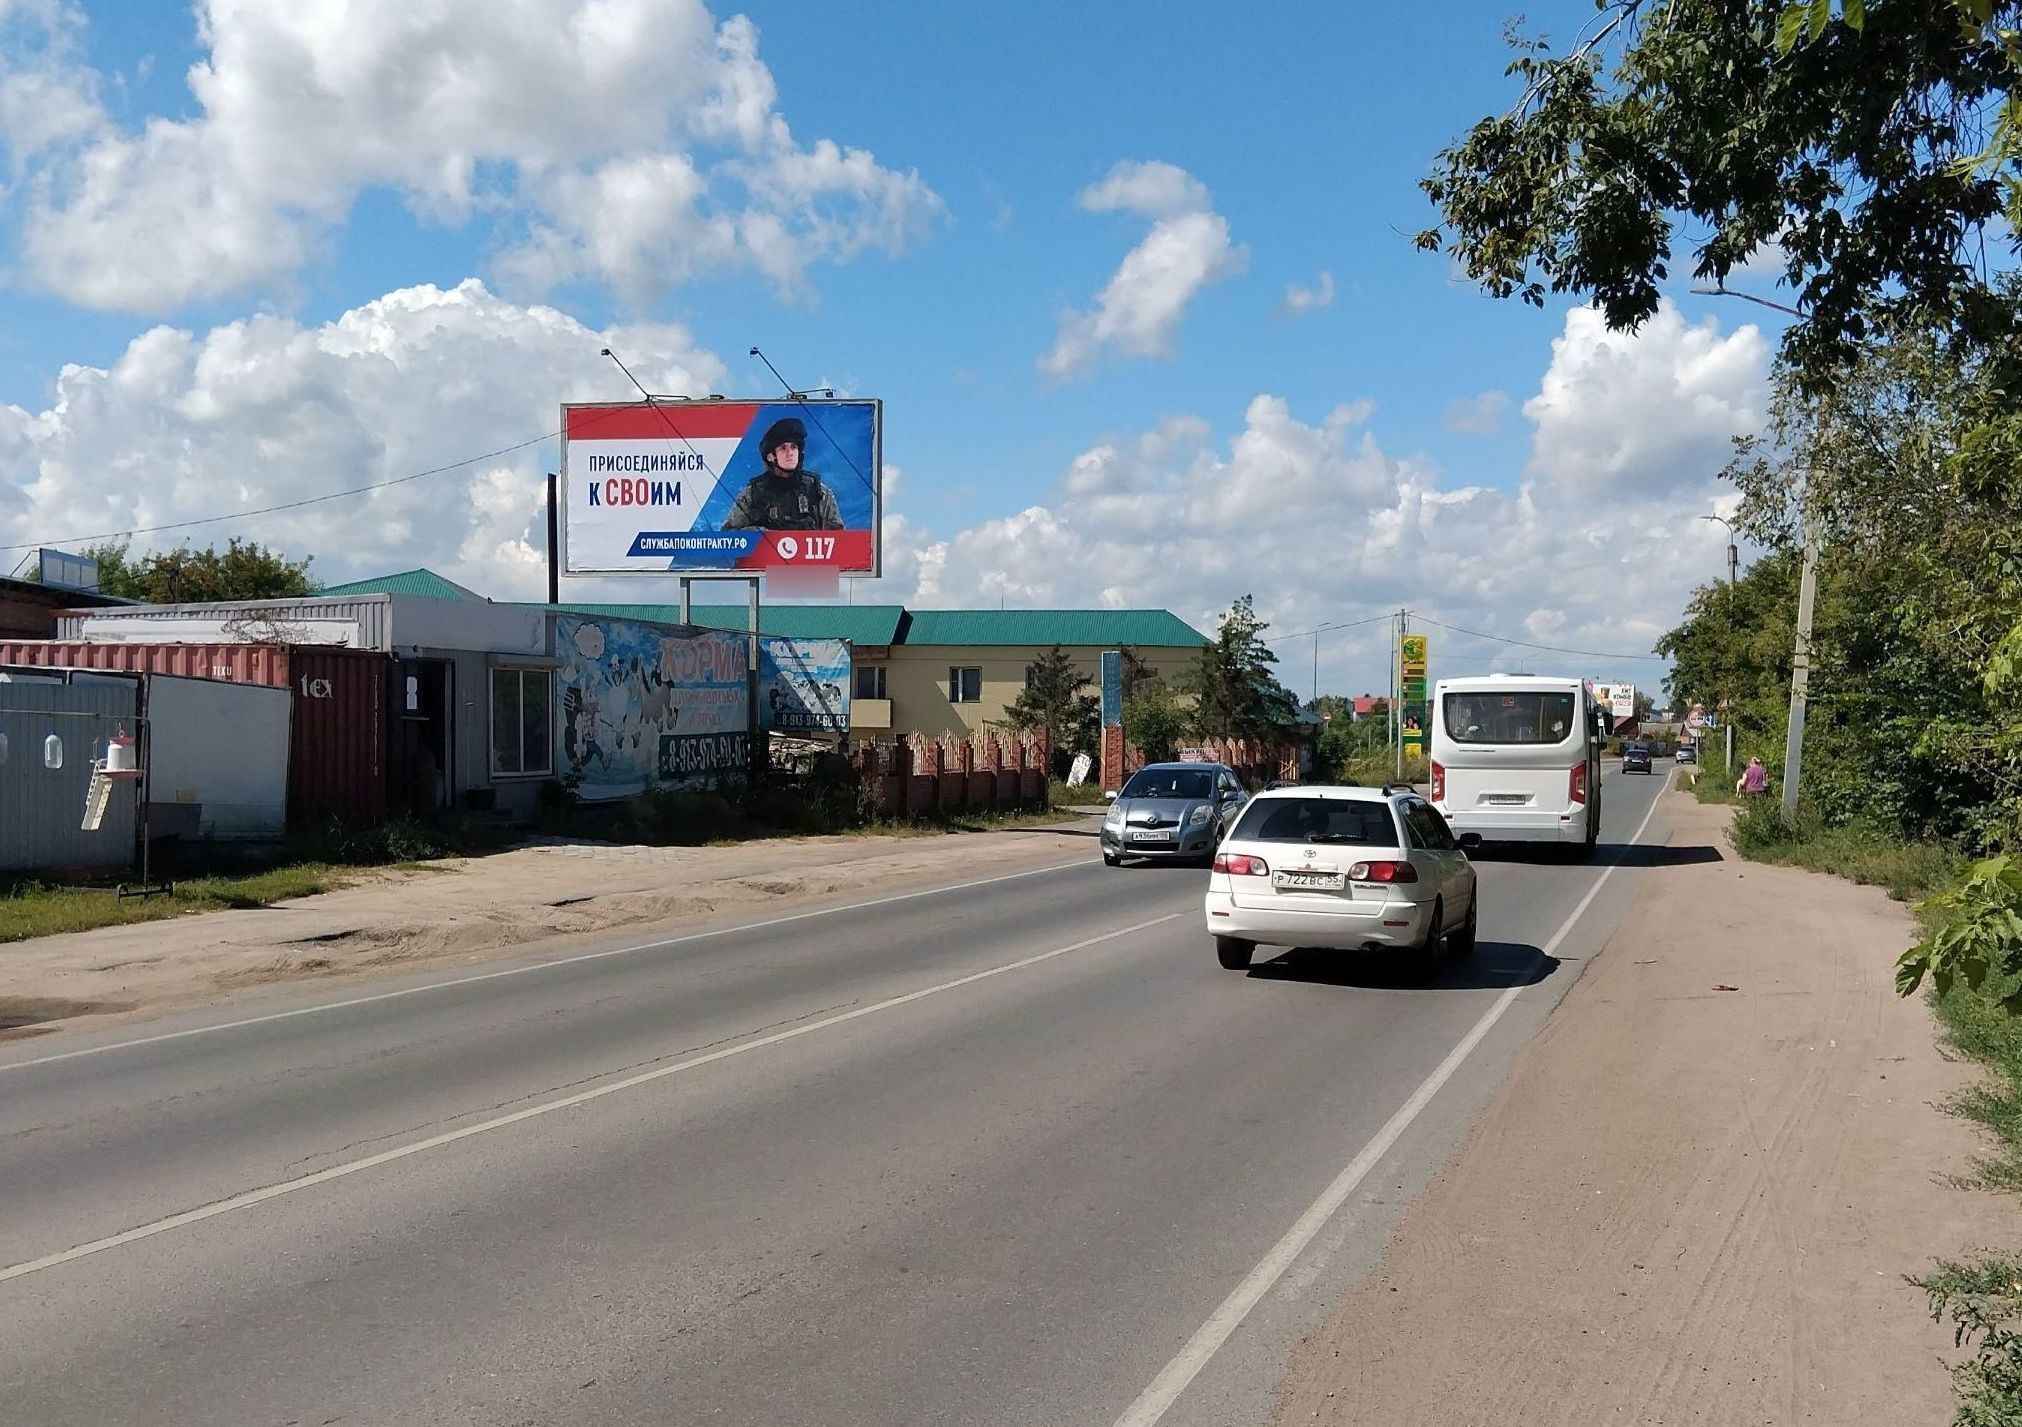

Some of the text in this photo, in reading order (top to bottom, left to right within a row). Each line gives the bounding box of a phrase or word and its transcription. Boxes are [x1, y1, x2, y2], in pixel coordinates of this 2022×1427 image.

[589, 451, 704, 473] ПРИСОЕДИНЯЙСЯ
[589, 478, 681, 506] К СВОИМ
[640, 537, 747, 550] СЛУЖБАПОКОНТРАКТУ.РФ
[805, 537, 835, 560] 117
[660, 638, 747, 682] КОРМА
[1076, 753, 1091, 768] СТО
